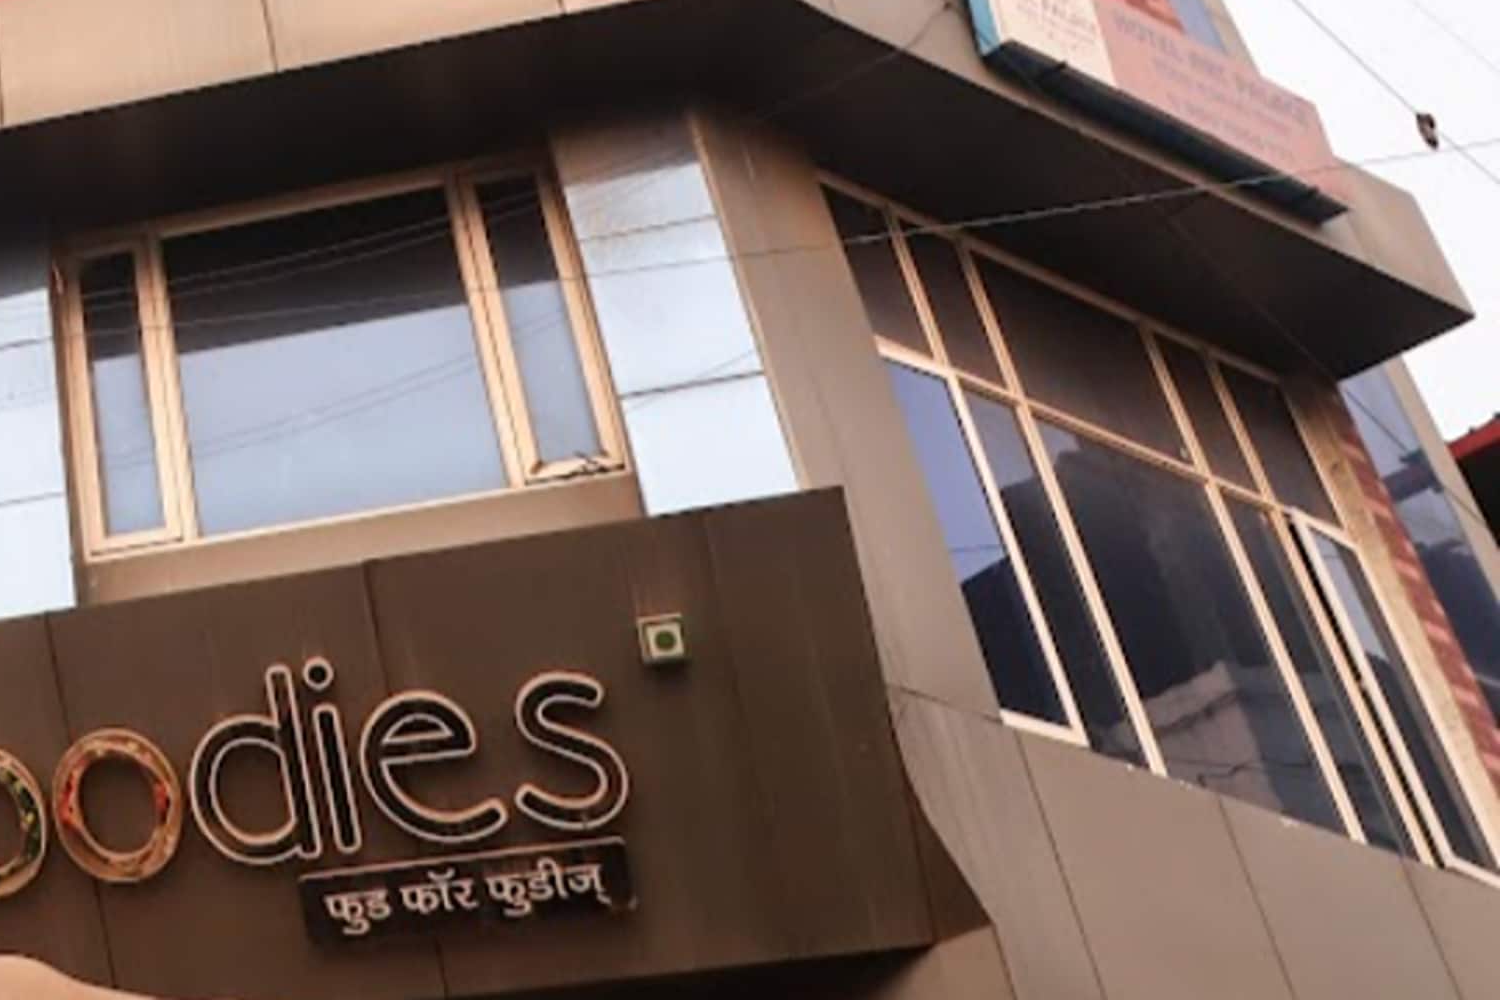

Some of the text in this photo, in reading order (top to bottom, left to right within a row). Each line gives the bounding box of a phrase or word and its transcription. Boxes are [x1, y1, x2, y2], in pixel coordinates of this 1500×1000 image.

[323, 856, 614, 935] फुड फॉर फुडीज्
